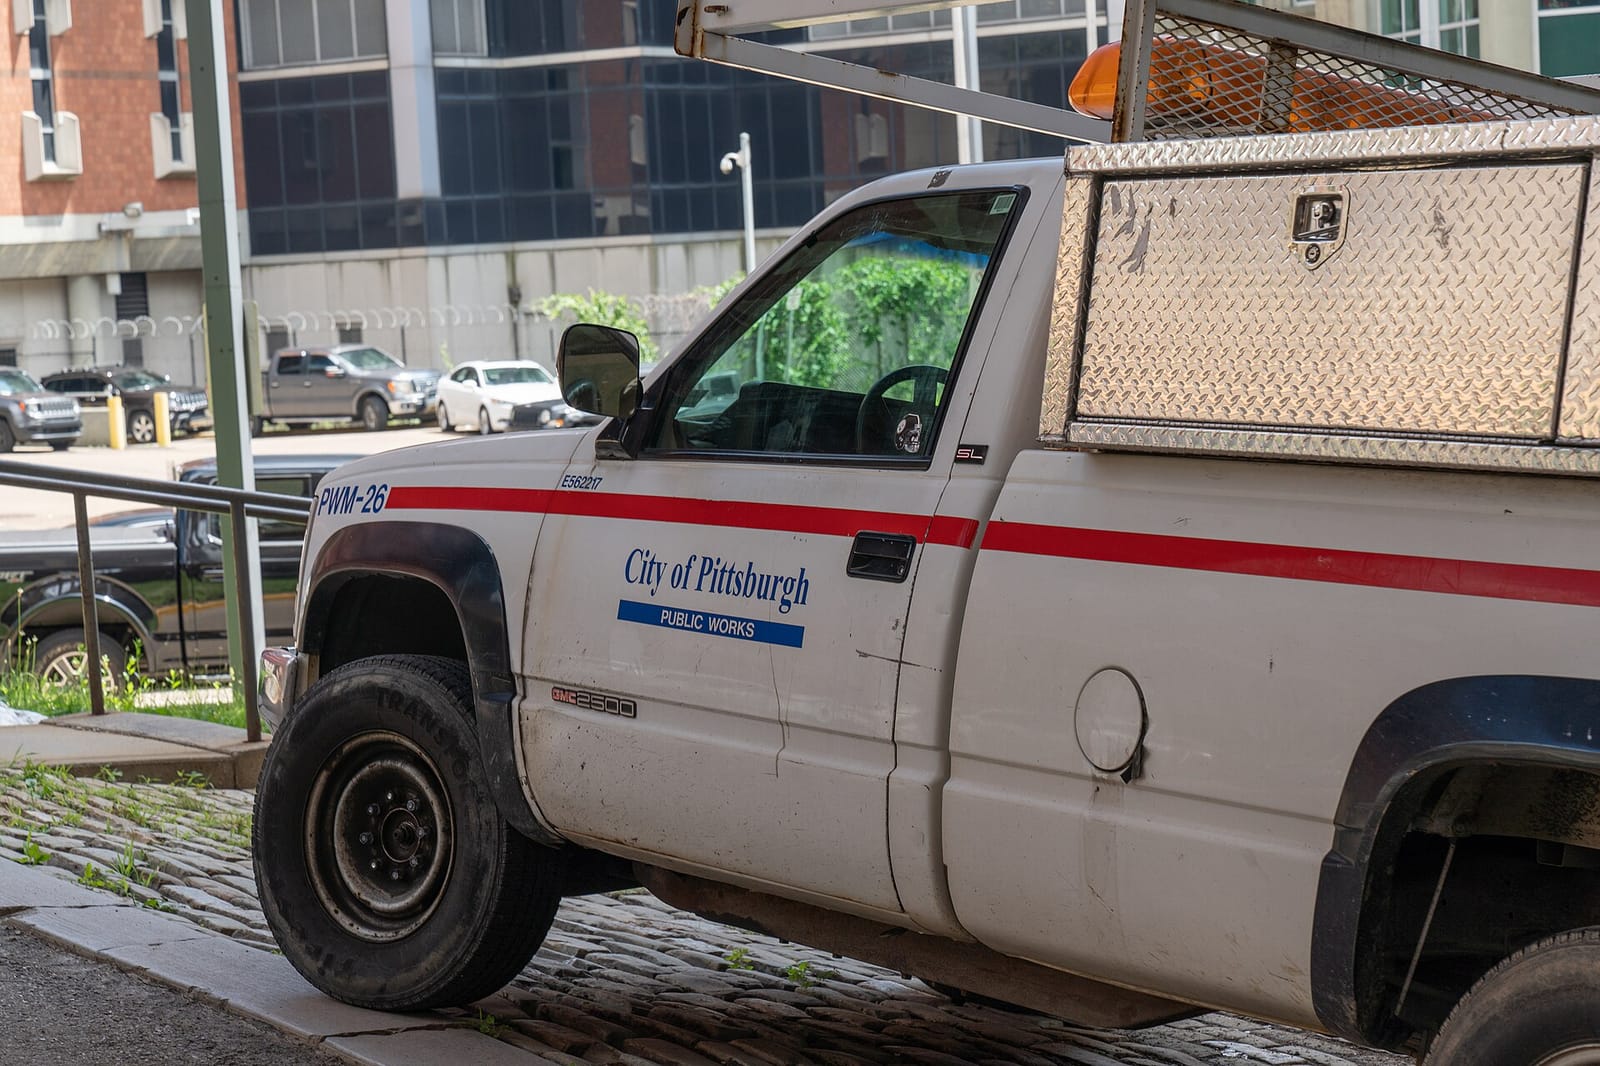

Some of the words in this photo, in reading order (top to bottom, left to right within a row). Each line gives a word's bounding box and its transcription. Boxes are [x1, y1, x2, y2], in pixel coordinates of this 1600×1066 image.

[956, 448, 983, 459] SL
[561, 475, 603, 490] E562217
[318, 483, 389, 516] PWM-26
[625, 548, 667, 596] City
[670, 554, 697, 589] of
[694, 556, 810, 614] Pittsburgh
[660, 609, 704, 630] PUBLIC
[708, 616, 755, 638] WORKS
